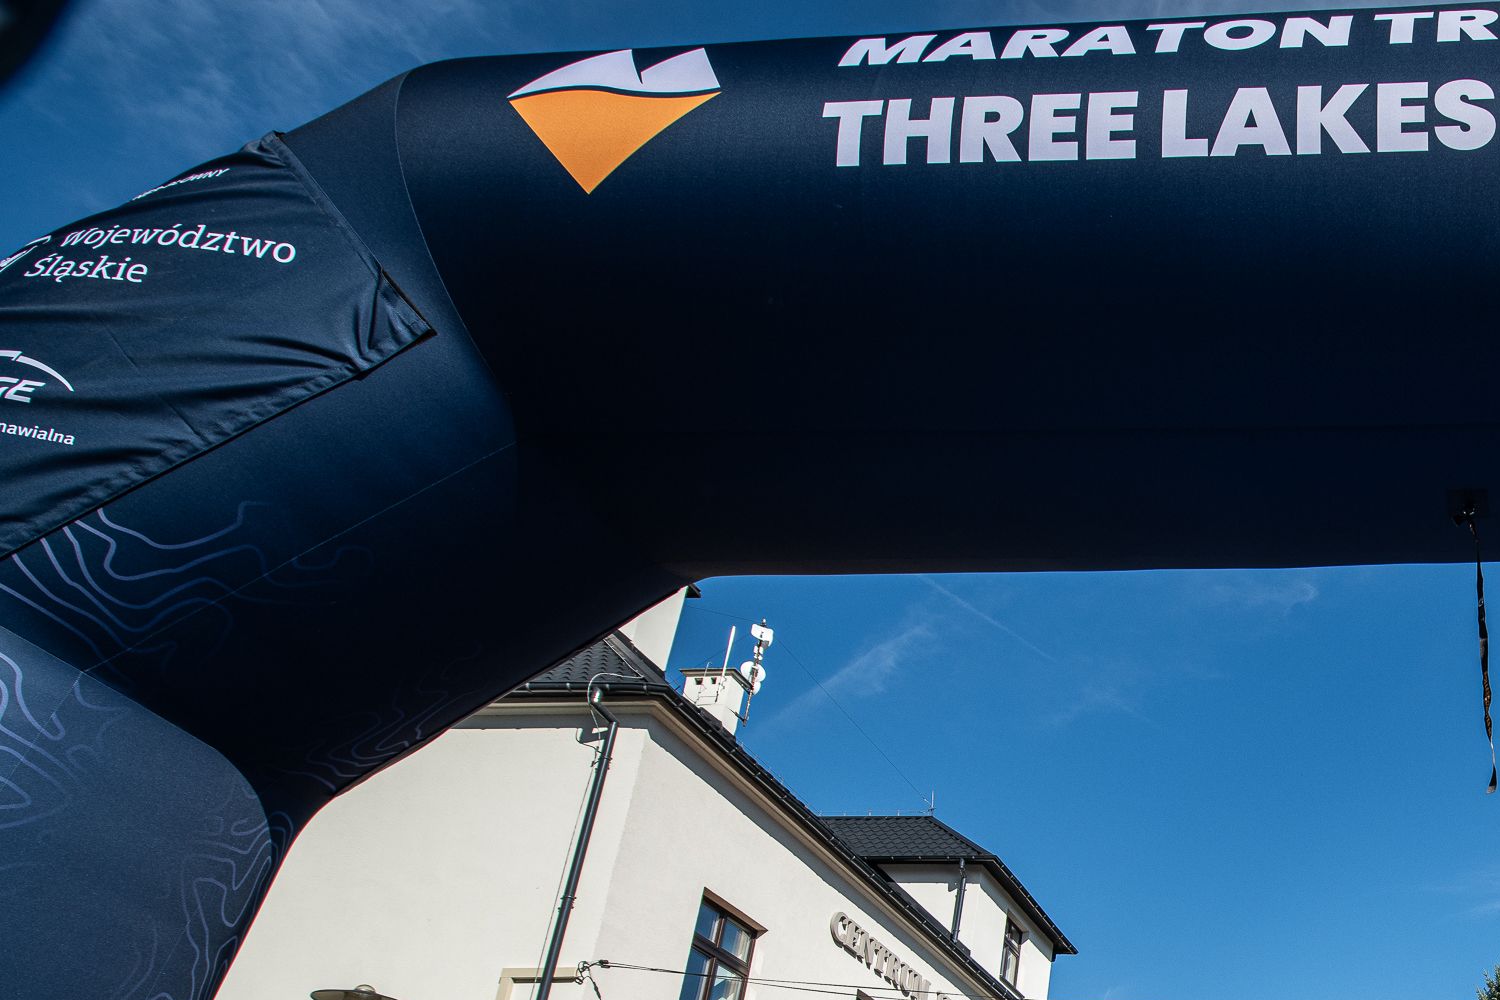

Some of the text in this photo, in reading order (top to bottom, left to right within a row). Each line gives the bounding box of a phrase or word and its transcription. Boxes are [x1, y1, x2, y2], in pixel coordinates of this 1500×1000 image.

[838, 16, 1353, 66] MARATON
[822, 91, 1139, 167] THREE
[1160, 78, 1497, 158] LAKES
[61, 223, 297, 264] Województwo
[24, 252, 149, 283] Śląskie
